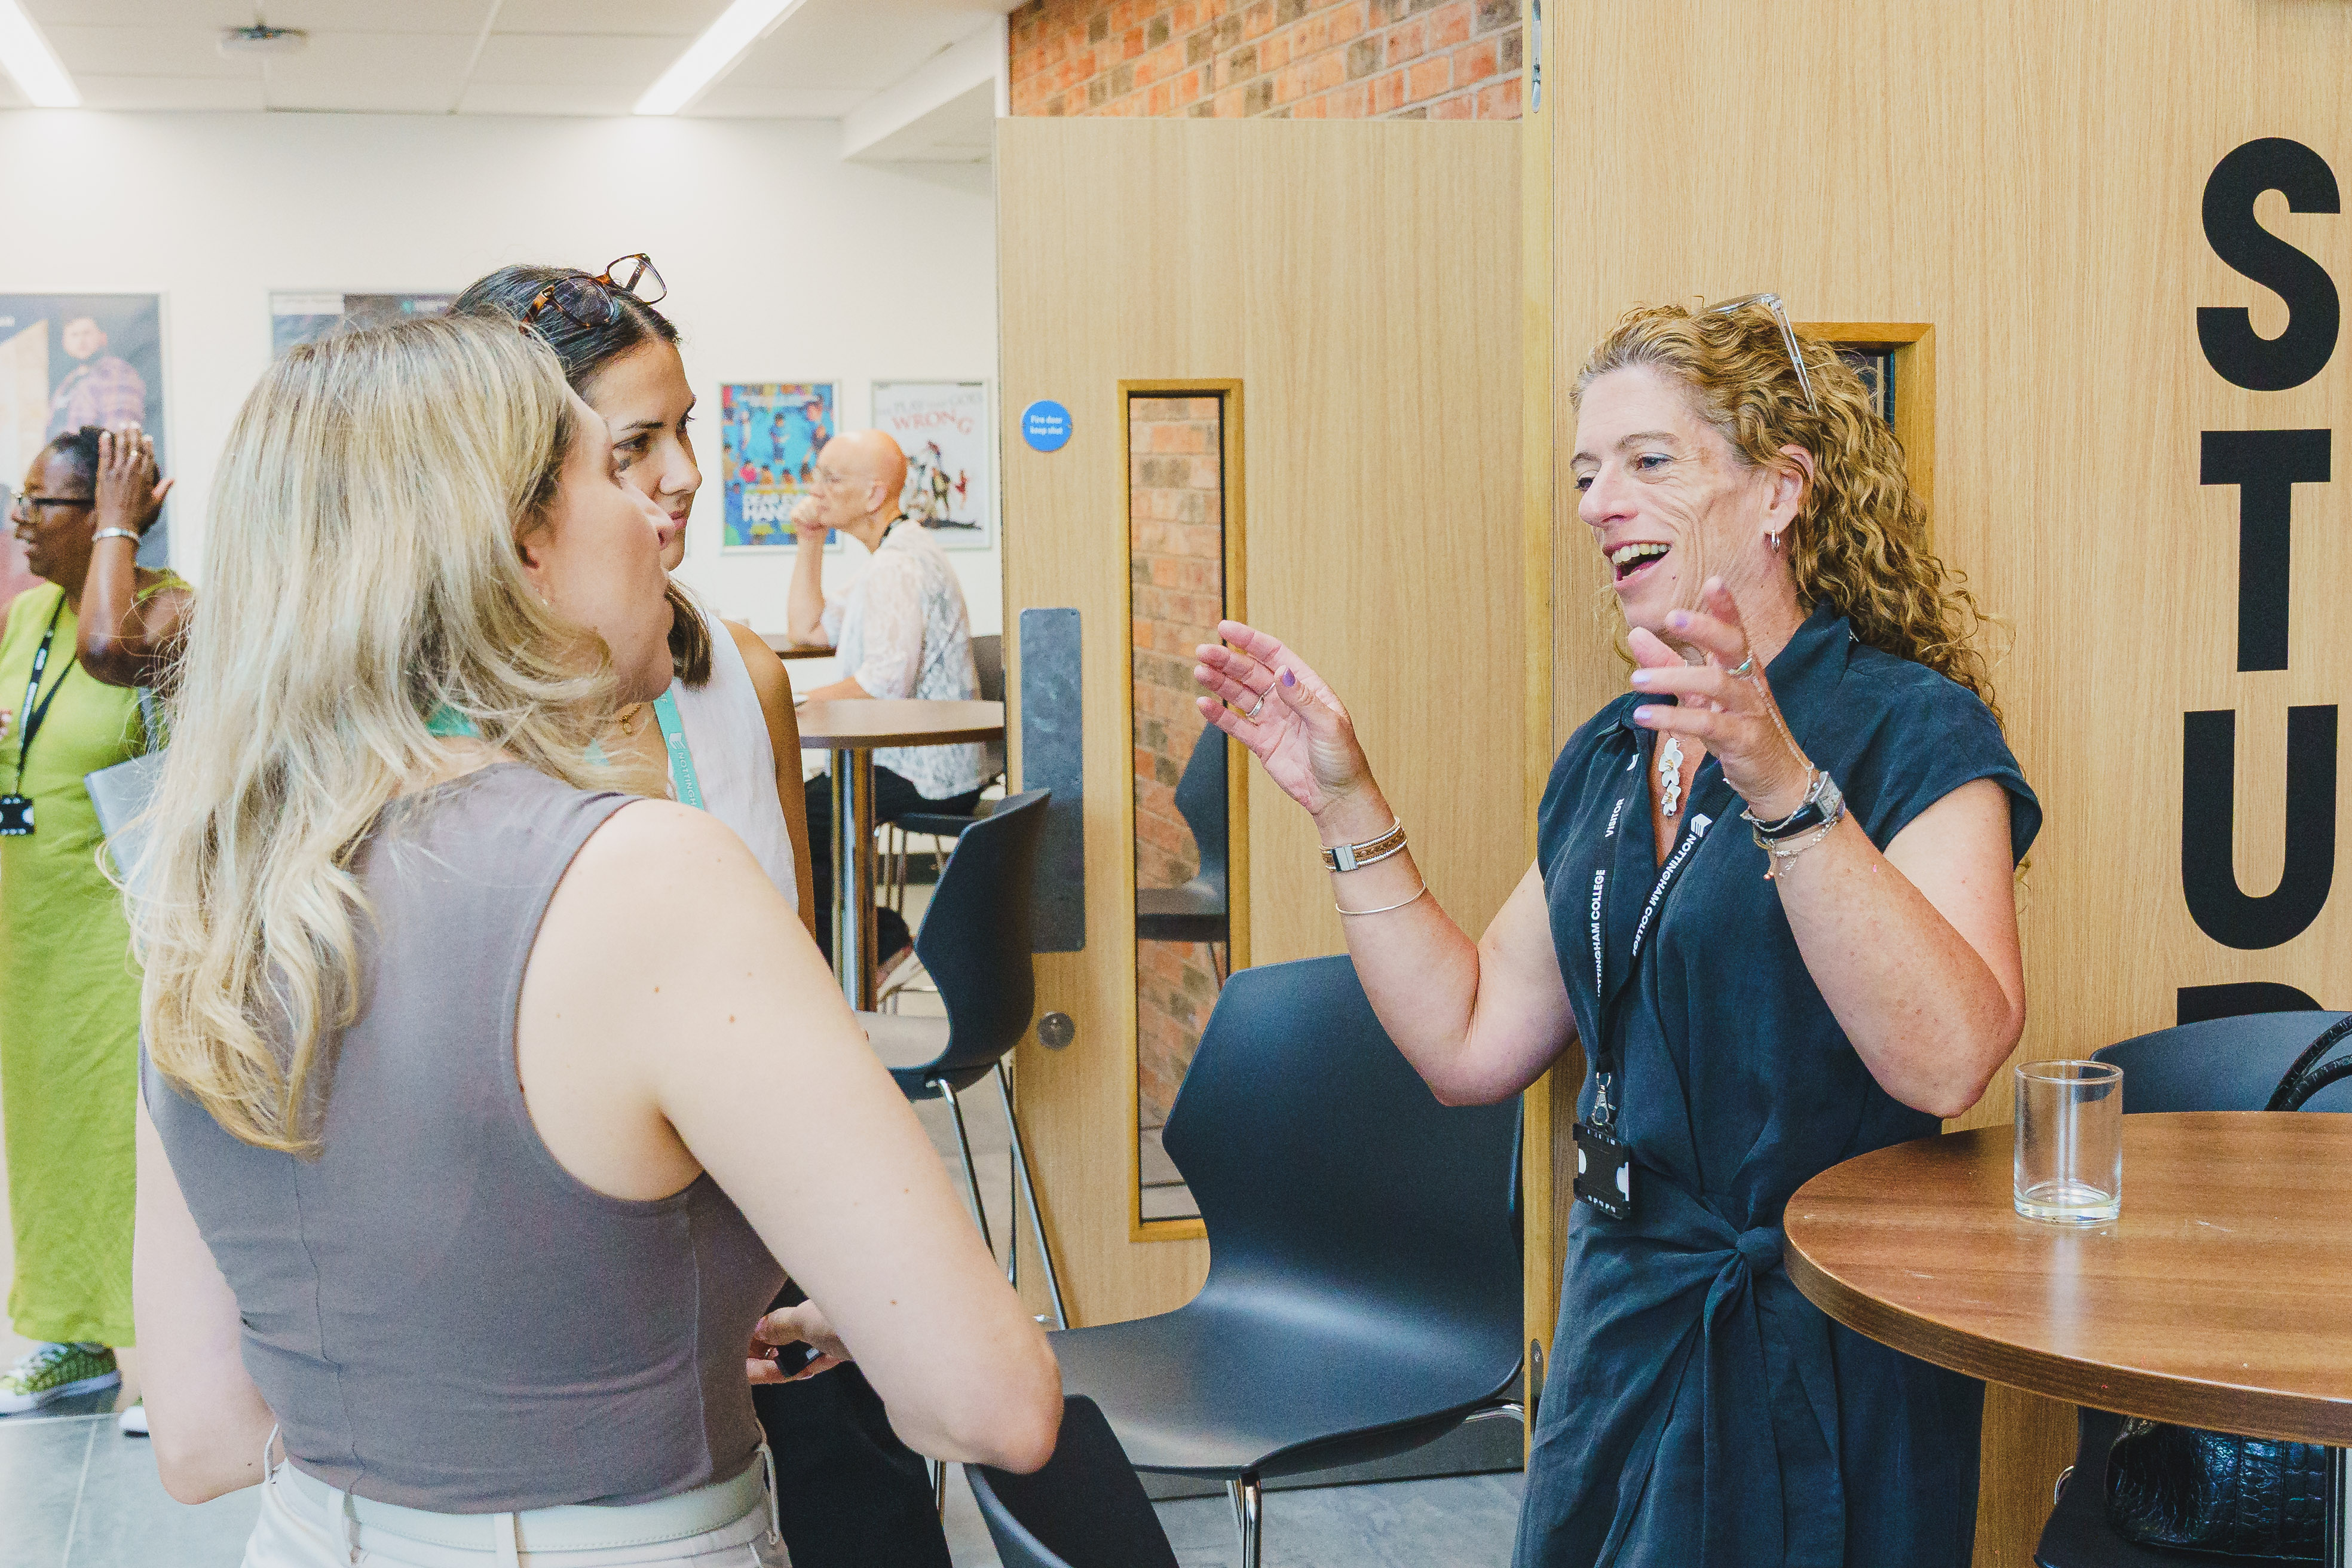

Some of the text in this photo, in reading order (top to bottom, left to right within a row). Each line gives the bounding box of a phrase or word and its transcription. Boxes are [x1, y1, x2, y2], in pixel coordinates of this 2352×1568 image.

[891, 408, 975, 436] WRONG
[1030, 415, 1062, 424] Fire door
[1030, 425, 1063, 436] keep shut
[678, 751, 698, 806] NOTTINGH
[1604, 798, 1625, 837] VISITOR
[1649, 834, 1696, 906] NOTTINGHAM
[1591, 869, 1606, 920] COLLEGE
